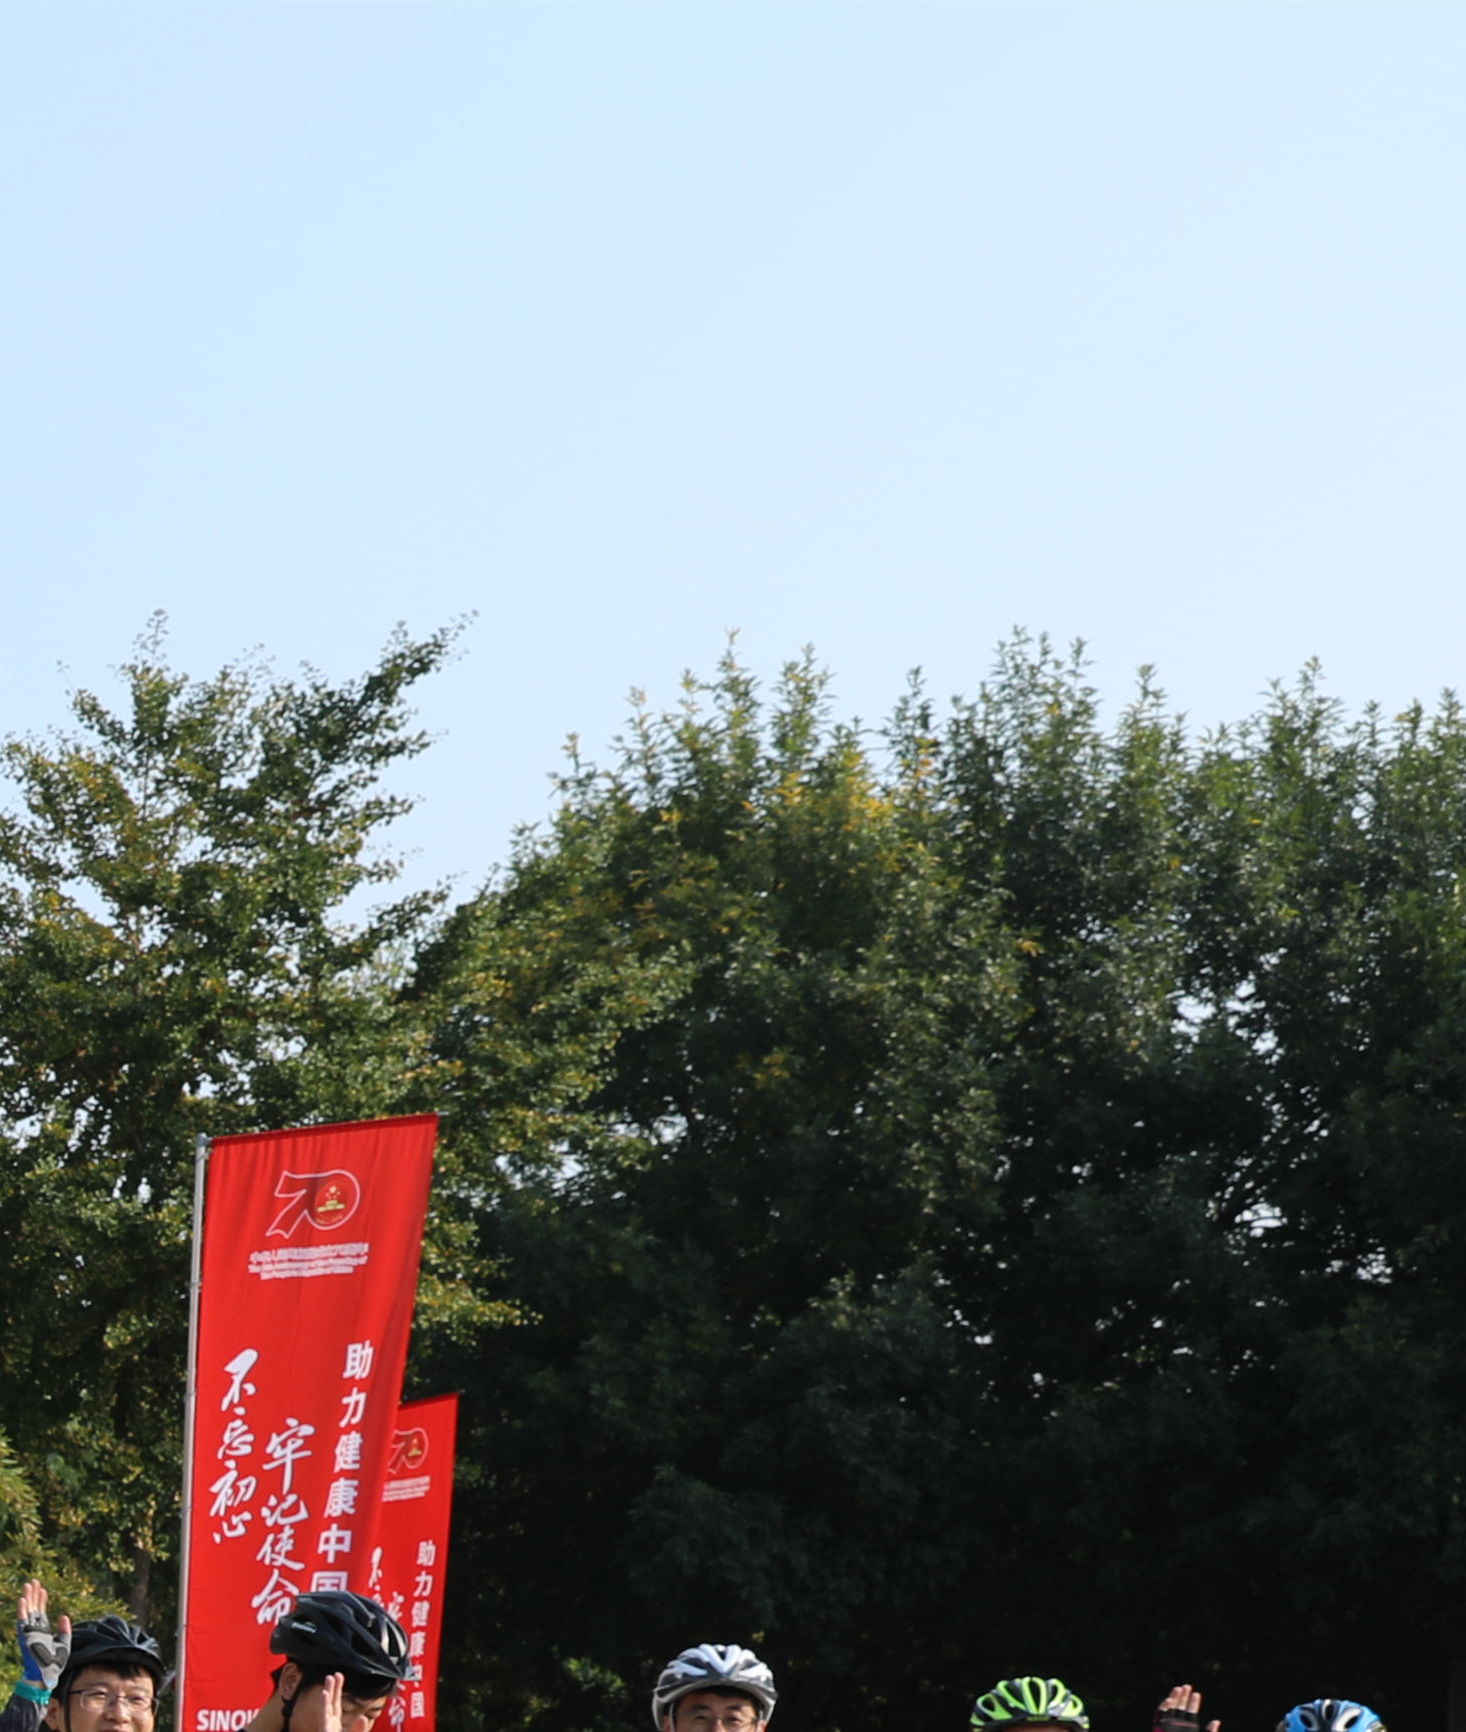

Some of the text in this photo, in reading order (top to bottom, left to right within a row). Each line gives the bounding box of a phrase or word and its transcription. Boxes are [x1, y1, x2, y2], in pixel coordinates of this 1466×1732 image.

[209, 1348, 258, 1544] 不忘初心
[251, 1418, 315, 1625] 牢记使命
[310, 1340, 374, 1593] 助力健康中国
